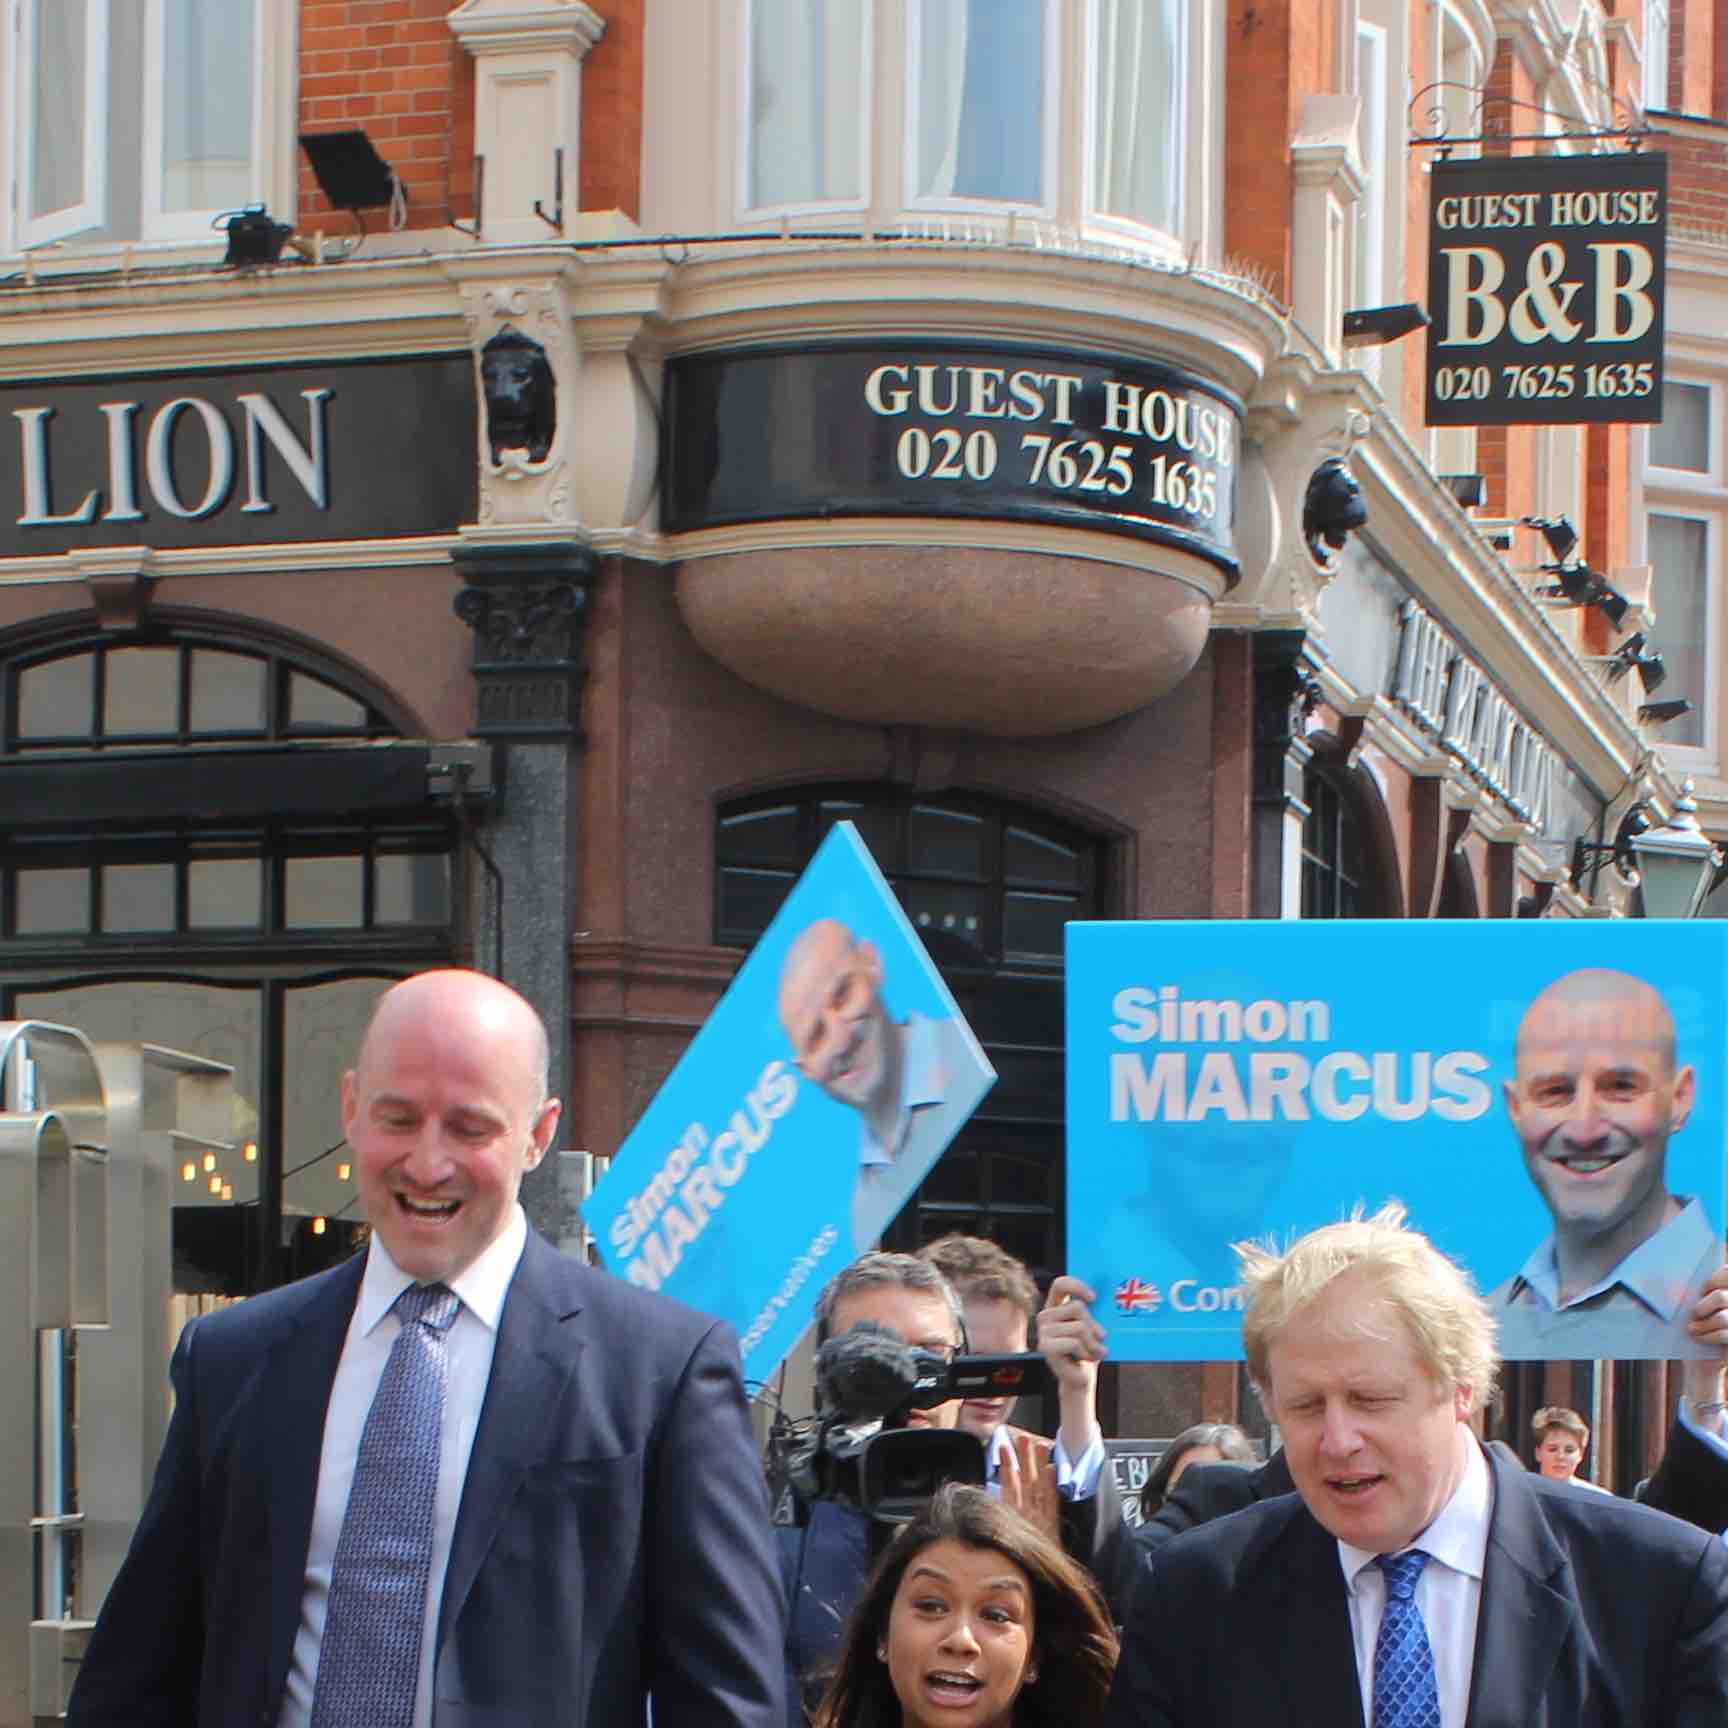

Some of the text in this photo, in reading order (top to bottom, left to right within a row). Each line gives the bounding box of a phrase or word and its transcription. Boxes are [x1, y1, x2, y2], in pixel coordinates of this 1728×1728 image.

[1435, 190, 1660, 231] GUEST HOUSE
[1437, 240, 1656, 348] B&B
[864, 363, 1234, 468] GUEST HOUSE
[1433, 361, 1655, 402] 020 7625 1635
[11, 387, 334, 528] LION
[896, 428, 1217, 520] 020 7625 1635
[1108, 985, 1331, 1045] Simon
[1108, 1050, 1493, 1123] MARCUS
[609, 1122, 710, 1259] Simon
[626, 1060, 800, 1293] MARCUS
[1168, 1279, 1248, 1313] Con
